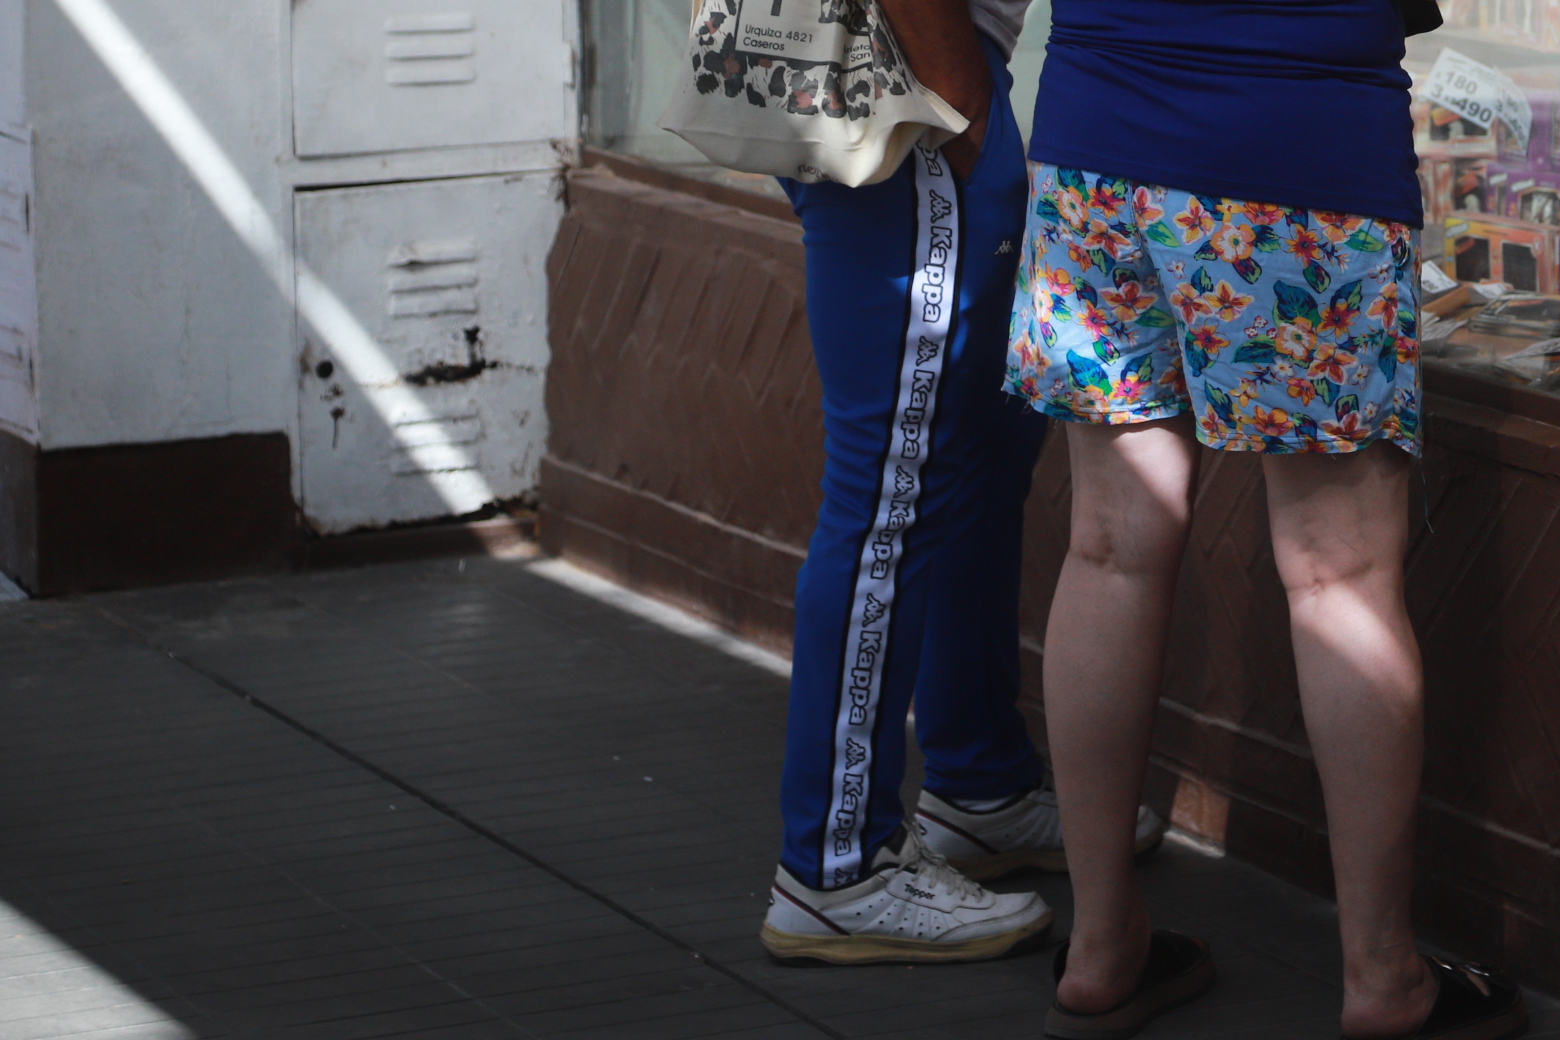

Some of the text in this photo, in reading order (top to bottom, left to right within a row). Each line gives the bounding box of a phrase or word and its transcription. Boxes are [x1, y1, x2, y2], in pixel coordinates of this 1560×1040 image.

[743, 36, 785, 51] Caseros
[745, 24, 813, 43] Urquiza 4821
[850, 51, 871, 62] San
[920, 226, 953, 323] Kappa
[901, 369, 935, 460] Kappa
[870, 501, 909, 580] Kappa
[849, 631, 882, 727] Kappa
[834, 773, 864, 858] Kappa
[904, 882, 936, 900] Topper
